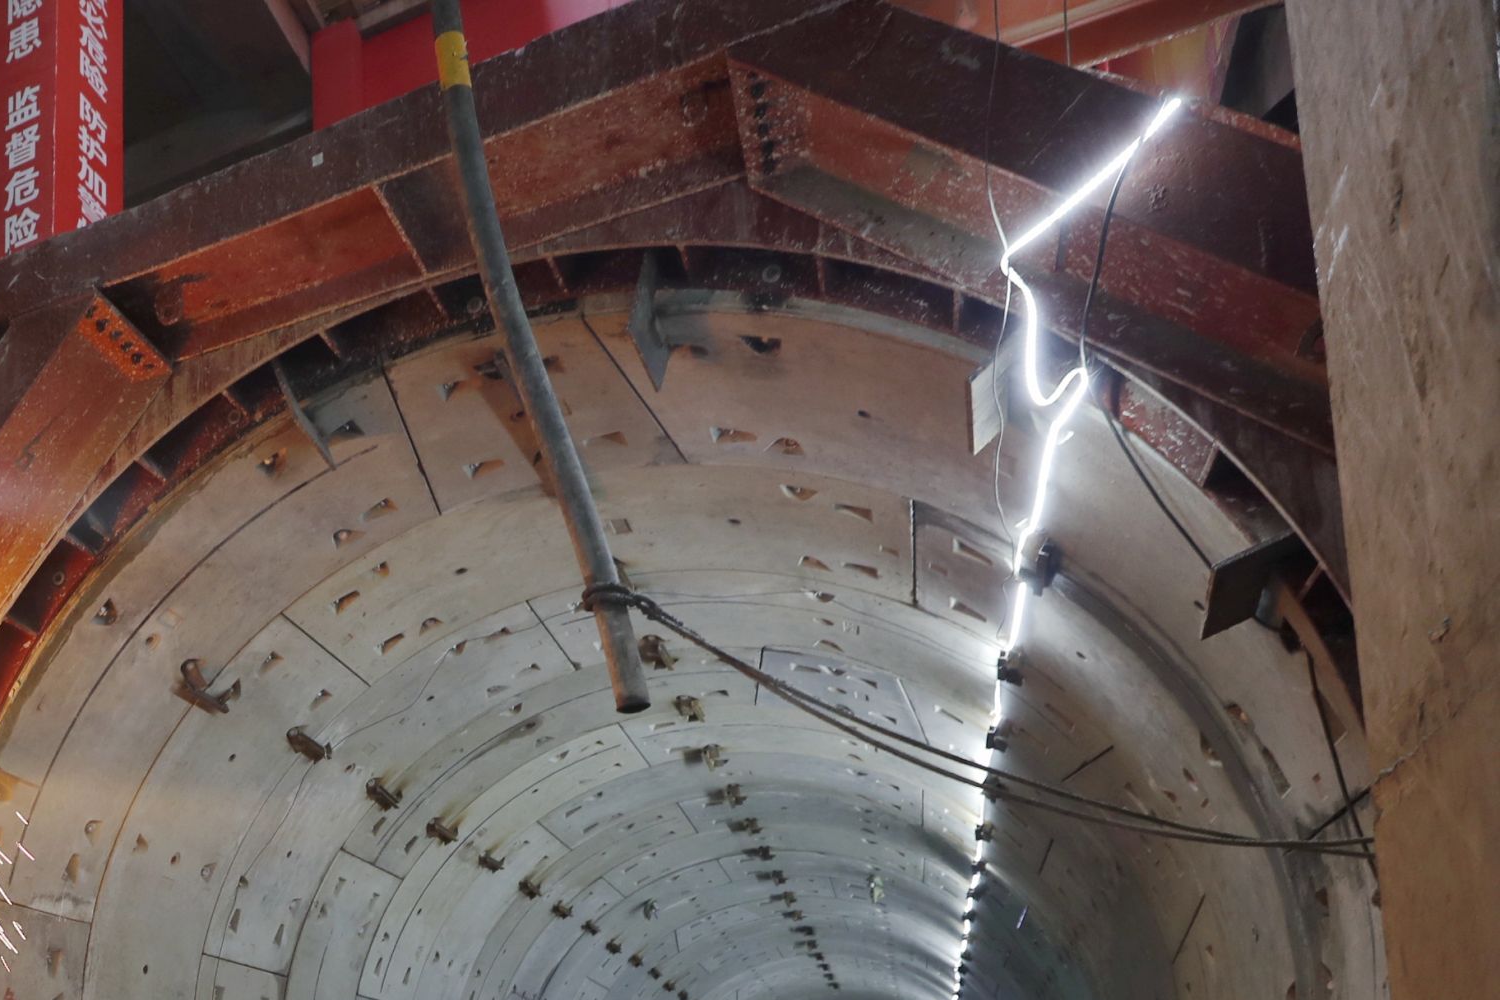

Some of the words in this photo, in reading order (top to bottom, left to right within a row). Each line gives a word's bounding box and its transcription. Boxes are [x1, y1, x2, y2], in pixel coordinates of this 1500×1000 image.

[79, 0, 107, 103] 必危险
[4, 84, 40, 256] 监督危险
[77, 92, 107, 229] 防护加警
